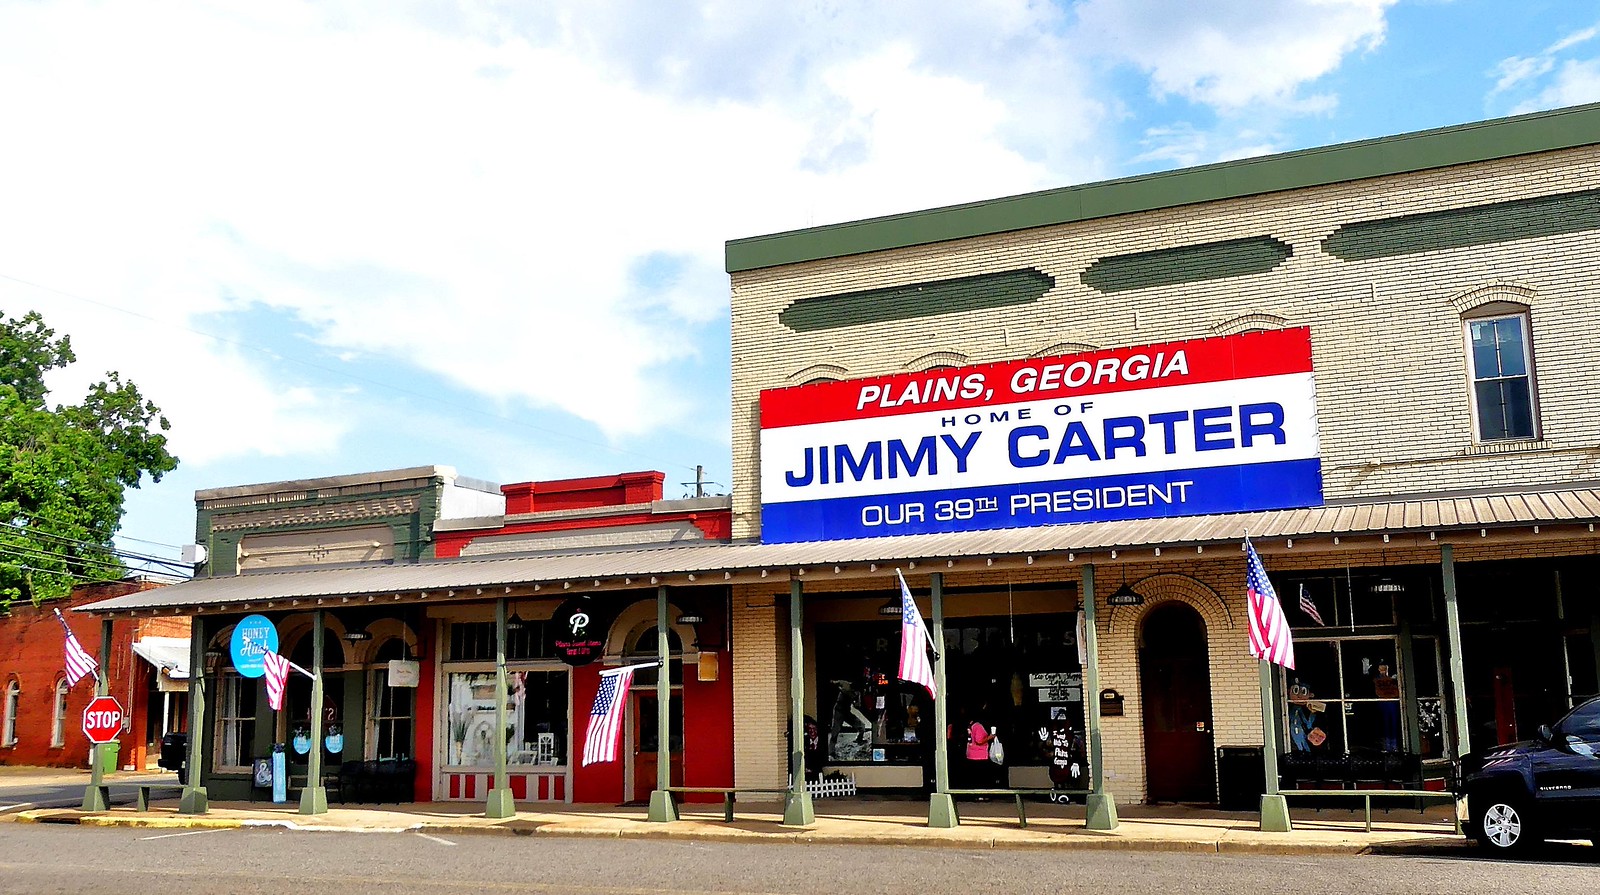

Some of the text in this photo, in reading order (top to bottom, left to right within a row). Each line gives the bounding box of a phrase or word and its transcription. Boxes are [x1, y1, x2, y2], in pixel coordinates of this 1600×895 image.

[857, 350, 1189, 410] PLAINS, GEORGIA
[941, 401, 1094, 428] HOME OF
[784, 401, 1287, 489] JIMMY CARTER
[862, 502, 925, 526] OUR
[1010, 480, 1194, 516] PRESIDENT
[242, 627, 270, 639] HONEY
[86, 710, 121, 729] STOP
